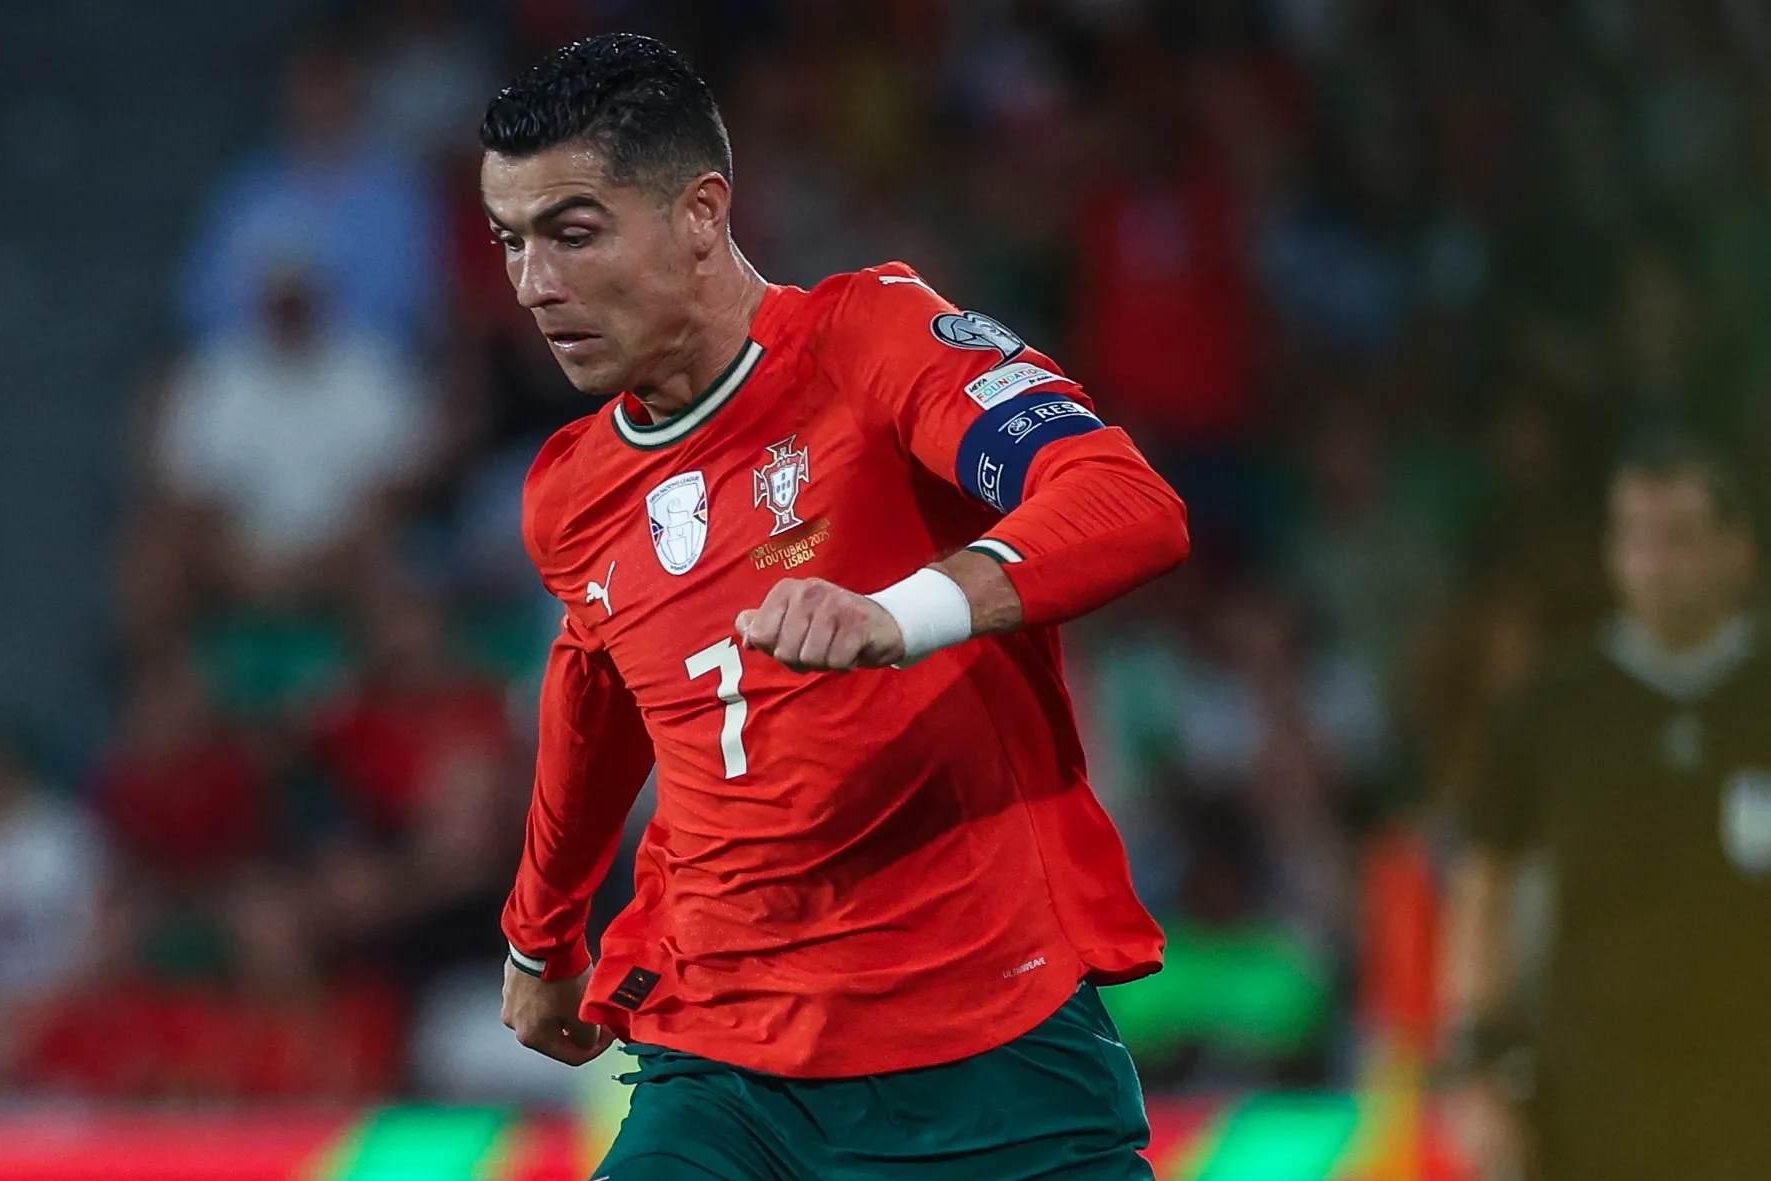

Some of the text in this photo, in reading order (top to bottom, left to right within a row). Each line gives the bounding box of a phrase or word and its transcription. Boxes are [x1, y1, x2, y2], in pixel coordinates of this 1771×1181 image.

[755, 558, 765, 571] 14
[765, 539, 808, 566] OUTUBRO
[783, 549, 815, 570] LISBOA
[684, 636, 748, 779] 7
